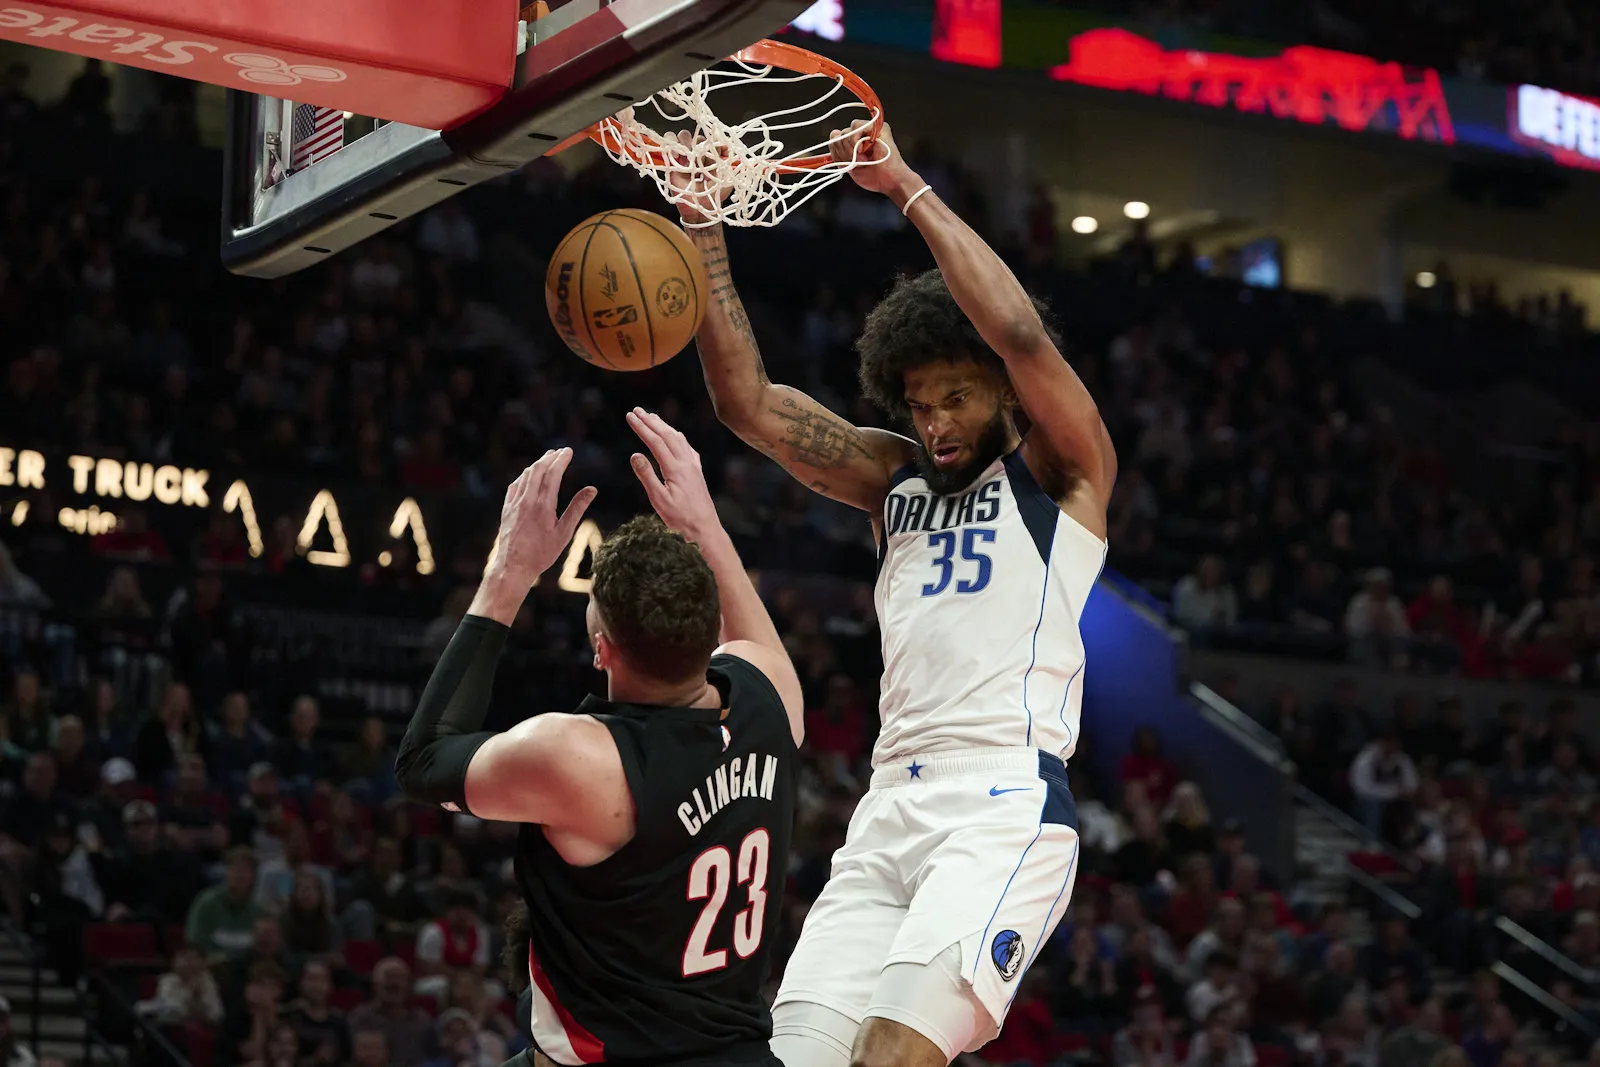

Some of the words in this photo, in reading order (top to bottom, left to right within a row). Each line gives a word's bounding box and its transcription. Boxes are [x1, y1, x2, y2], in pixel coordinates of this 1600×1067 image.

[0, 8, 218, 65] State
[0, 447, 46, 489] ER
[68, 455, 209, 508] TRUCK
[887, 480, 1001, 536] DALLAS
[920, 528, 997, 598] 35
[677, 753, 778, 837] CLINGAN
[682, 826, 770, 978] 23
